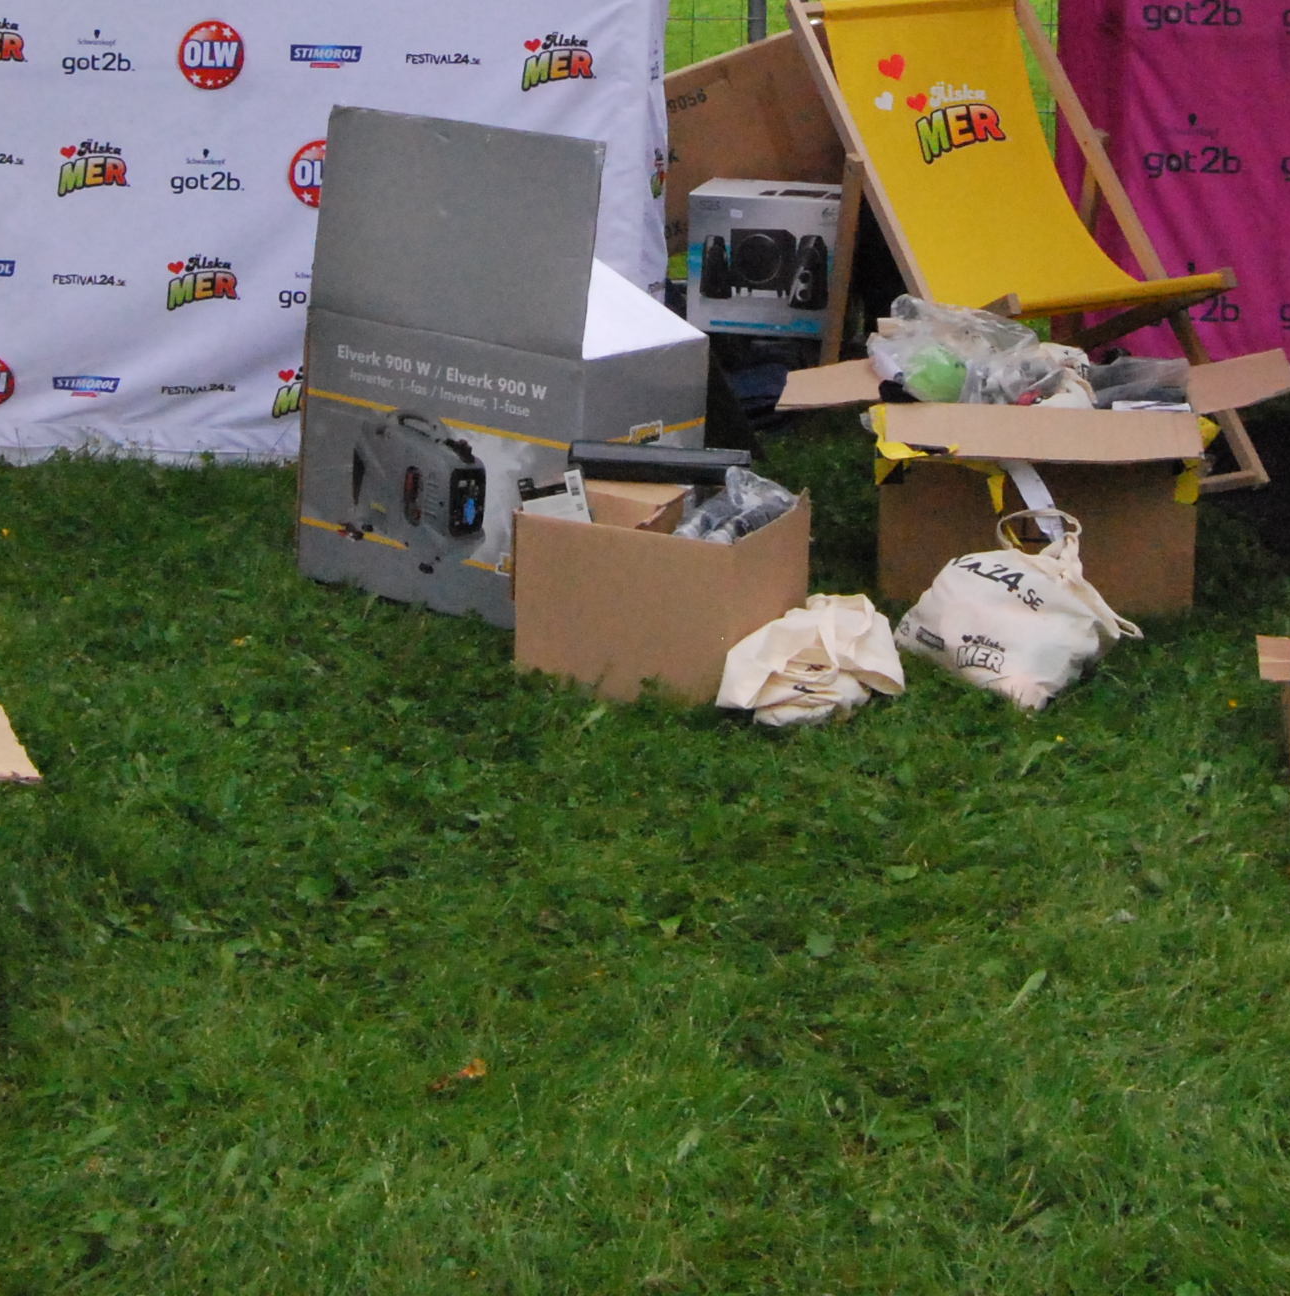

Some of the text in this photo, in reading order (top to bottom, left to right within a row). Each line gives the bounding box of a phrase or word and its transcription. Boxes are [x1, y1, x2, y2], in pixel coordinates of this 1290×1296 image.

[62, 51, 133, 76] got2b
[183, 40, 239, 68] OLW
[293, 46, 360, 61] STIMOROL
[521, 48, 592, 93] MER
[928, 81, 987, 108] Älska
[915, 102, 1007, 165] MER
[294, 160, 324, 187] OL
[1143, 145, 1242, 179] got2b
[57, 155, 128, 198] MER
[170, 170, 241, 195] got2b
[166, 270, 237, 313] MER
[55, 377, 118, 392] STIMOROL
[337, 344, 381, 367] Elverk
[385, 354, 412, 374] 900
[416, 360, 432, 377] W
[446, 367, 493, 391] Elverk
[497, 377, 527, 397] 900
[531, 384, 548, 401] W
[492, 396, 530, 418] 1-fase
[956, 644, 1005, 674] MER
